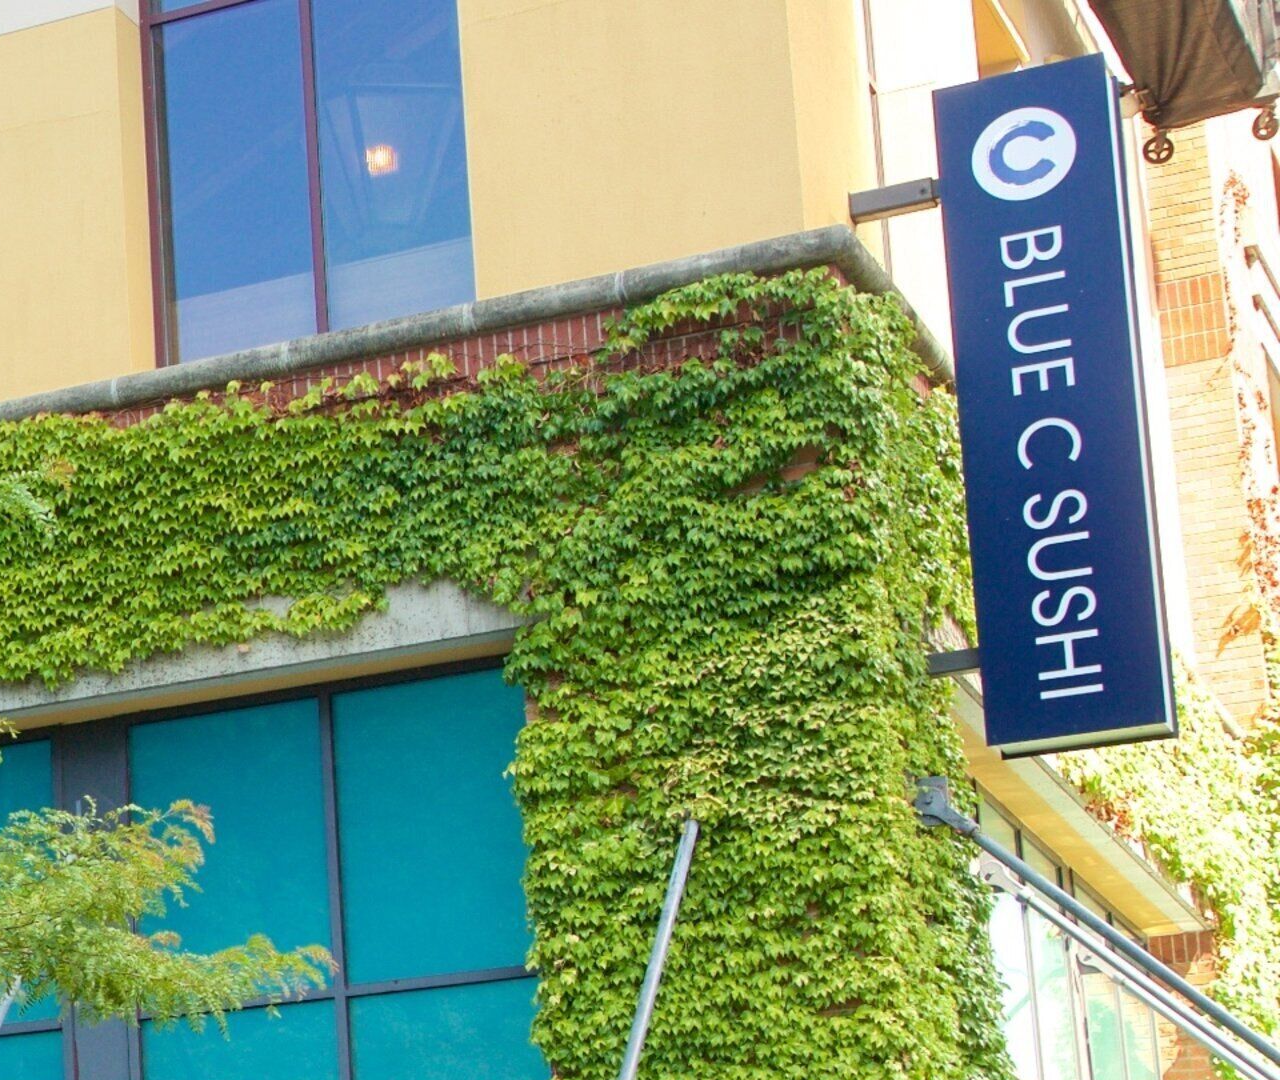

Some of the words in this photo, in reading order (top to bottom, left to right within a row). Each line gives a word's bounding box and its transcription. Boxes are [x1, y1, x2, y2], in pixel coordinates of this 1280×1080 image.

[999, 224, 1076, 397] BLUE
[1016, 416, 1082, 470] C
[1022, 488, 1104, 700] SUSHI
